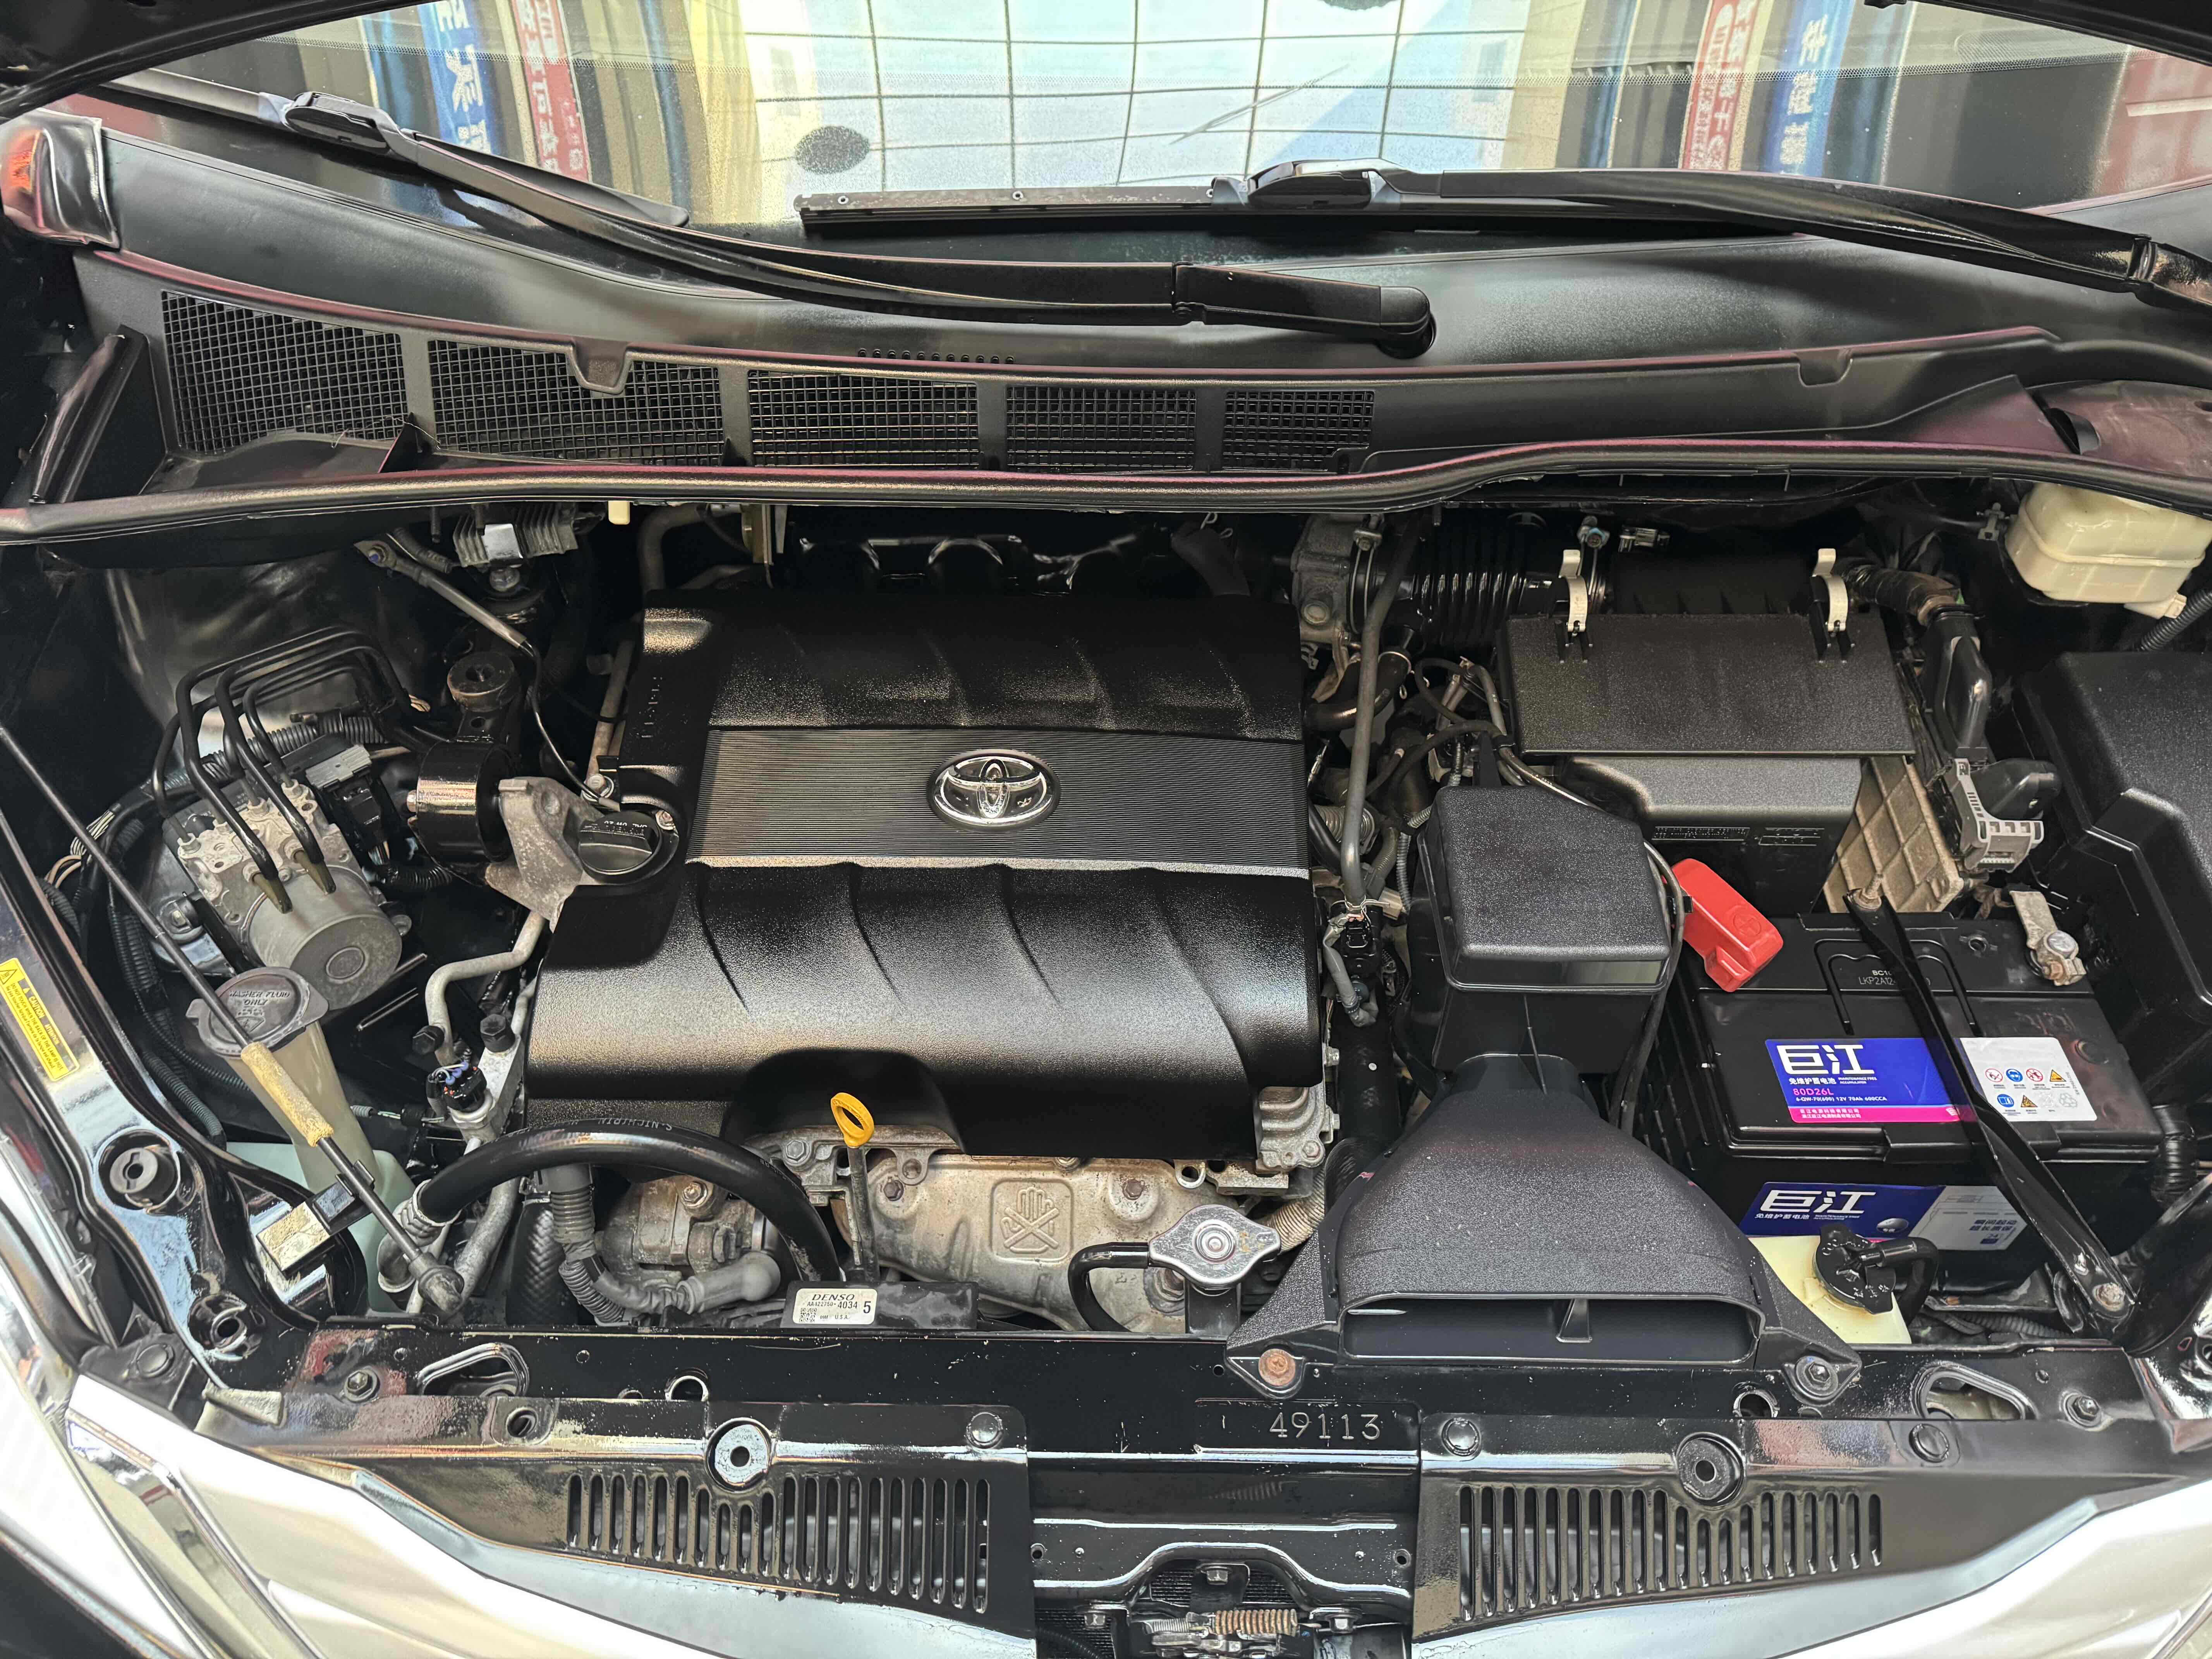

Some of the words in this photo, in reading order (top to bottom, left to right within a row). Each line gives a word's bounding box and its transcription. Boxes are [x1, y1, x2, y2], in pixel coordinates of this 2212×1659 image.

[28, 995, 45, 1018] CAUTION
[1776, 1044, 1875, 1075] 巨江
[1788, 1077, 1837, 1085] 免维护蓄电池
[1793, 1088, 1834, 1096] 80D26L
[1760, 1189, 1876, 1215] 巨江
[863, 1301, 871, 1314] 5
[1269, 1412, 1381, 1441] 49113
